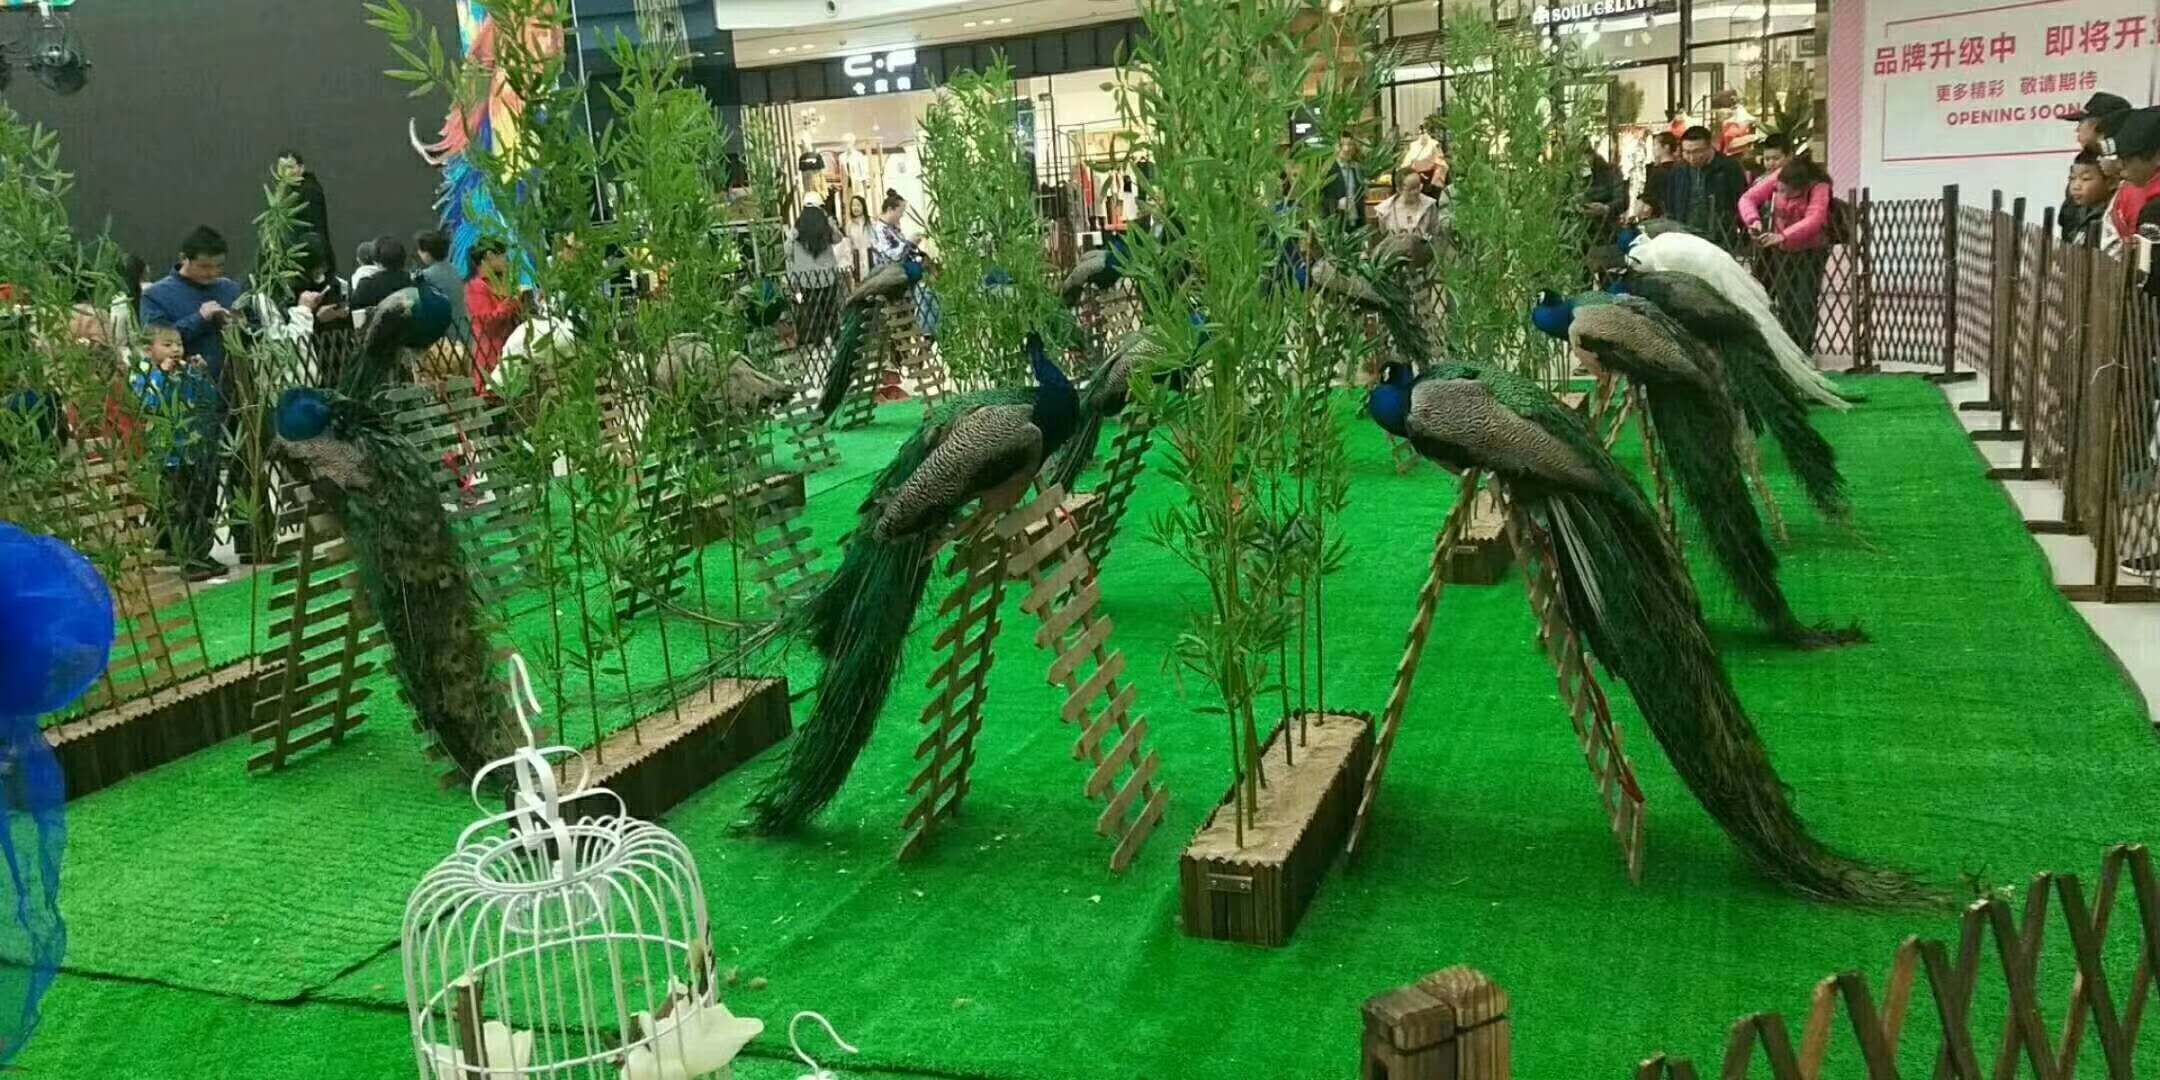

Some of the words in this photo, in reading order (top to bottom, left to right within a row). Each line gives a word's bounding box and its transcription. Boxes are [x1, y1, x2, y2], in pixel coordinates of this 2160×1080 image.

[1873, 31, 2017, 75] 品牌升级中
[1936, 79, 2005, 102] 更多精彩
[2020, 70, 2098, 95] 敬请期待
[1947, 107, 2025, 126] OPENING
[2030, 102, 2080, 120] SOON
